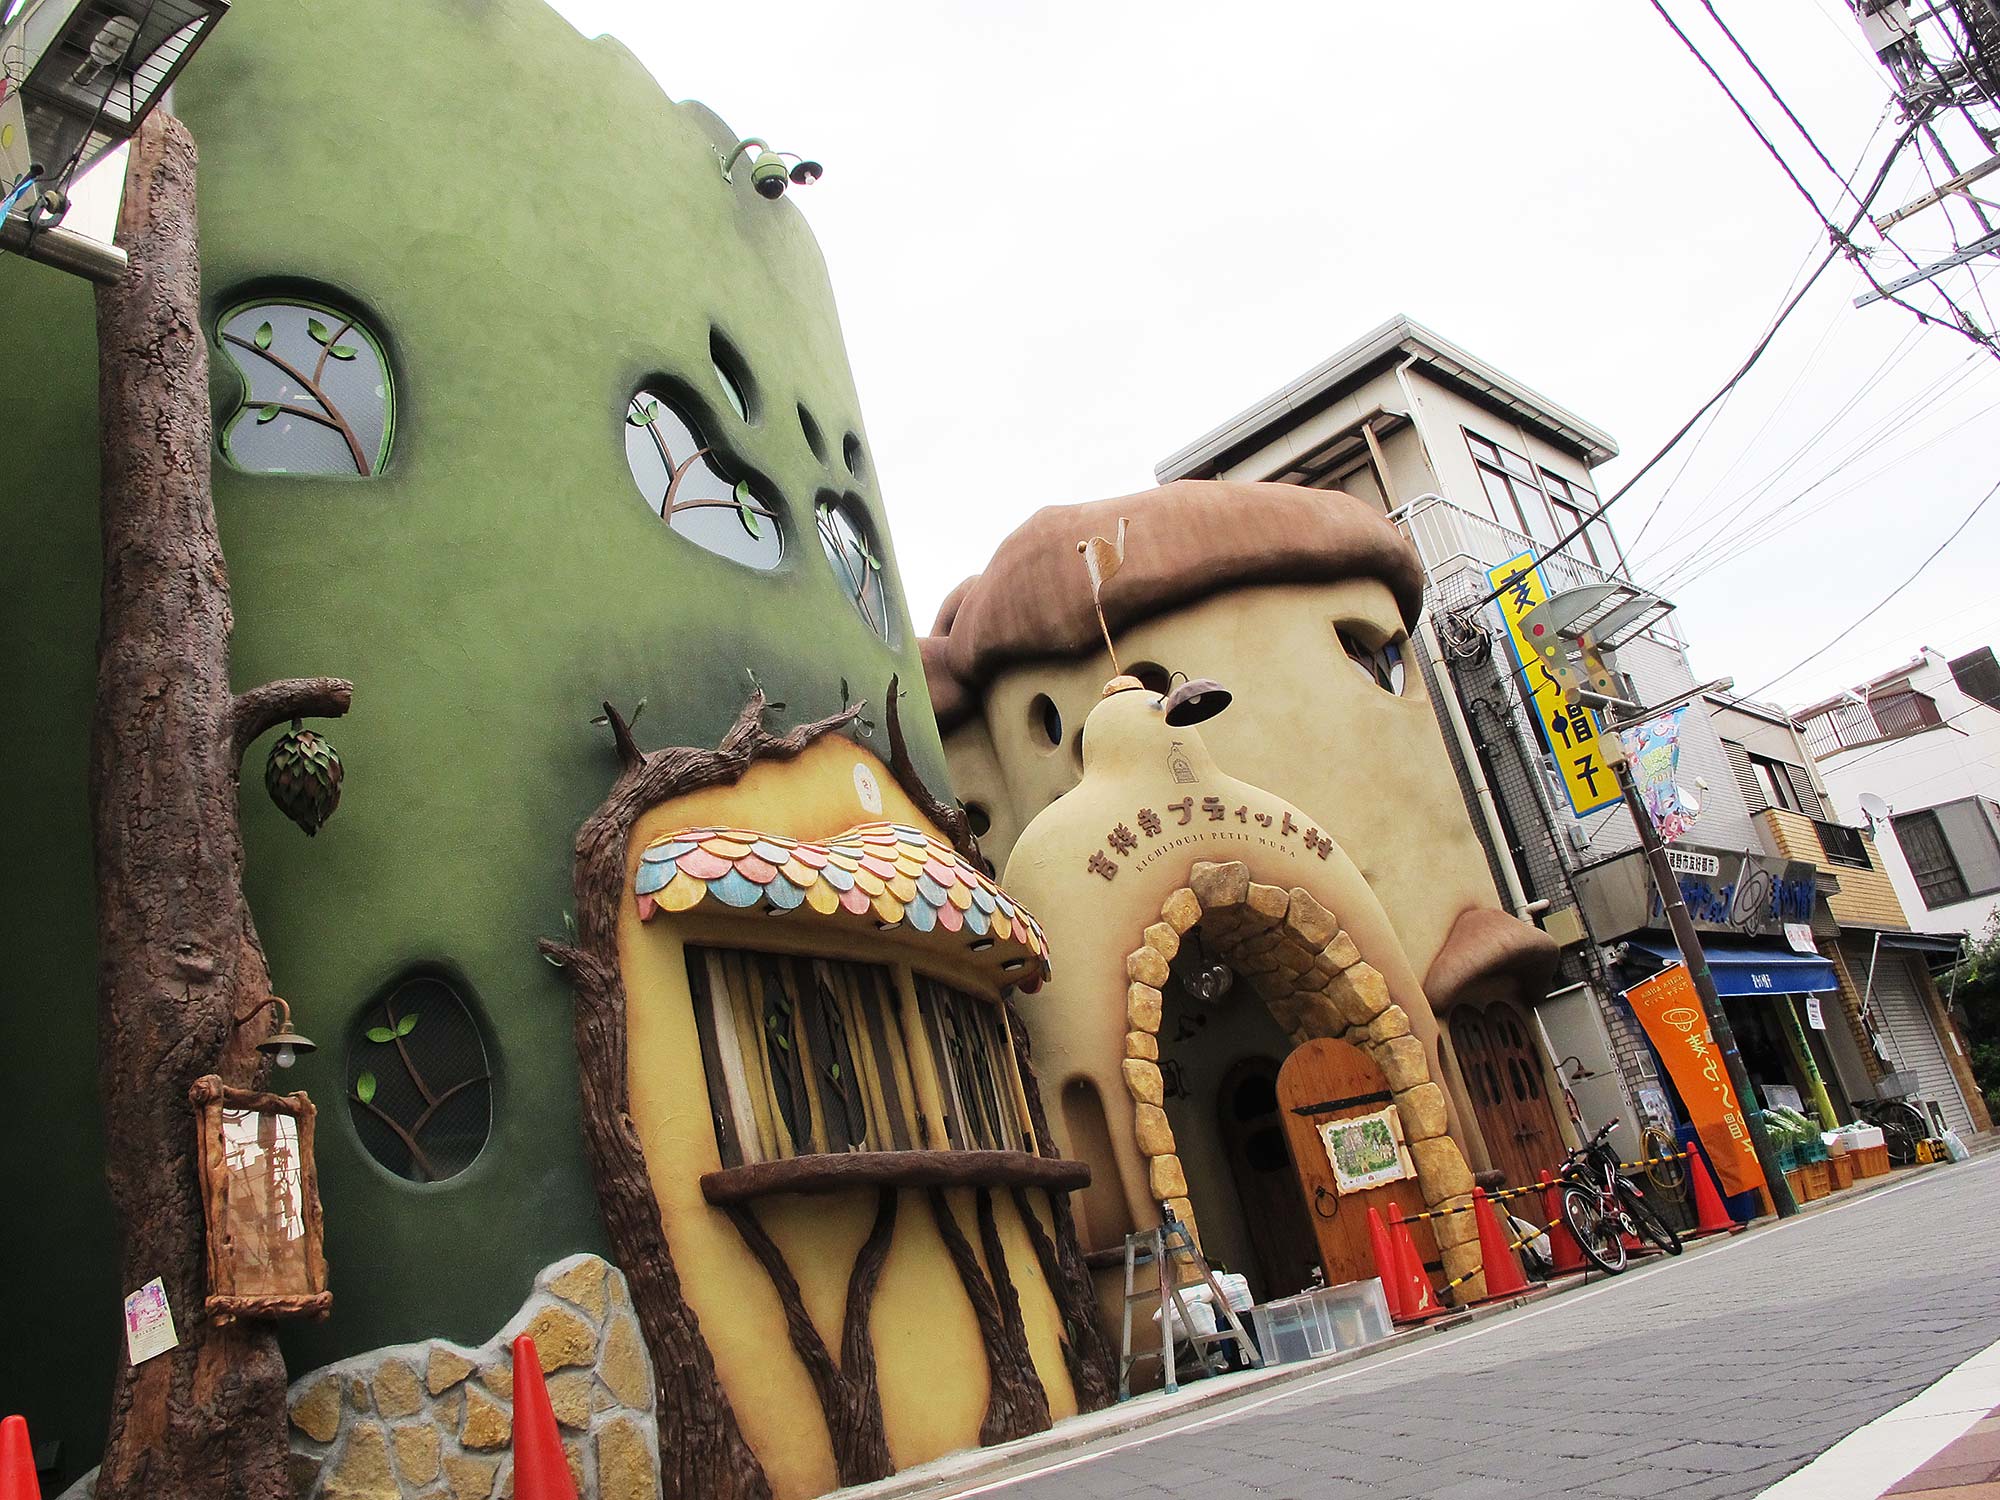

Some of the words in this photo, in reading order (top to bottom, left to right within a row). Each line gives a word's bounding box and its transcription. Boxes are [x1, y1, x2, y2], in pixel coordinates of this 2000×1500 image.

[1501, 569, 1599, 798] 麦ら帽子
[1087, 796, 1333, 881] 吉祥寺プティット村
[1135, 833, 1204, 873] KICHIJOUJI
[1211, 832, 1249, 841] PETIT
[1258, 837, 1296, 858] MURA
[1666, 852, 1715, 873] 蔵野市友好都市
